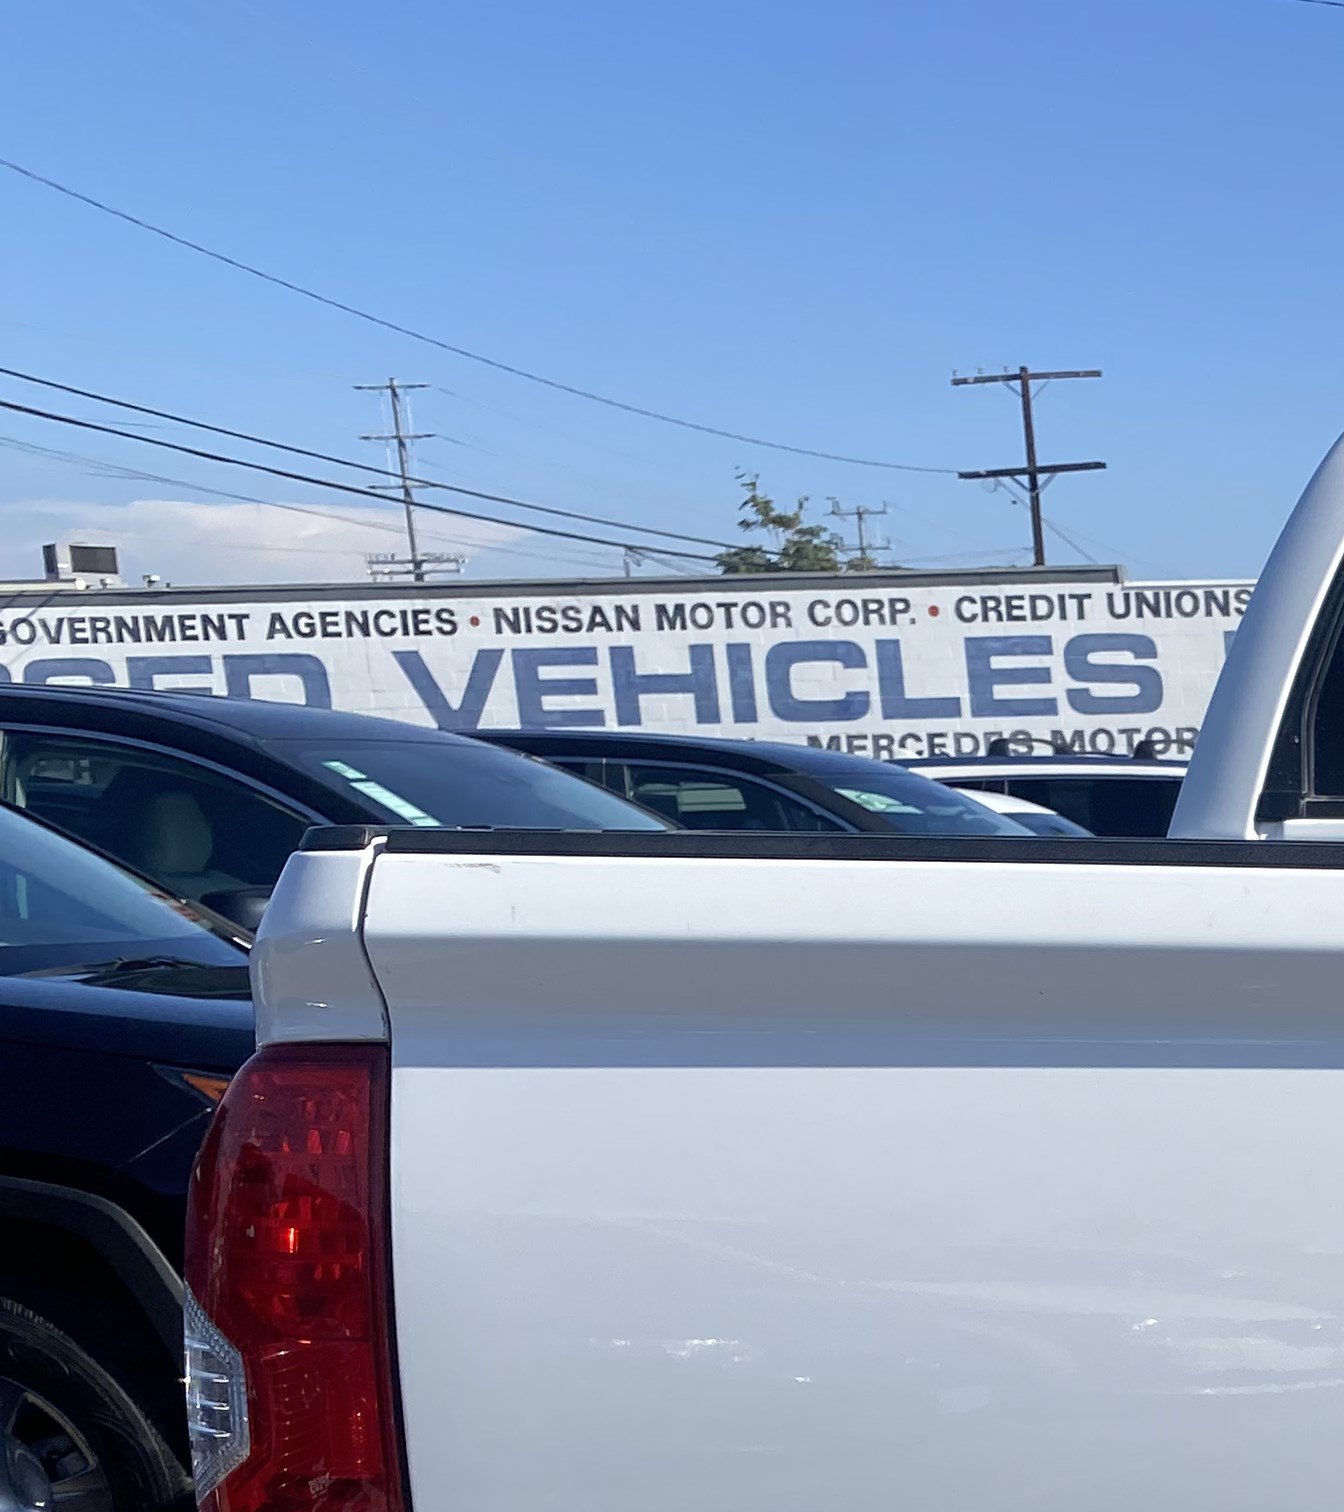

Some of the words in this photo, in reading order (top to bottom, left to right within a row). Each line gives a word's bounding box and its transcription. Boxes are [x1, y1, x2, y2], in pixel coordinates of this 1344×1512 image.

[0, 612, 249, 645] OVERNMENT
[266, 607, 458, 641] AGENCIES
[494, 604, 642, 635] NISSAN
[656, 600, 790, 632] MOTOR
[808, 597, 917, 628] CORP.
[955, 593, 1092, 624] CREDIT
[1105, 588, 1253, 620] UNIONS
[392, 632, 1164, 731] VEHICLES
